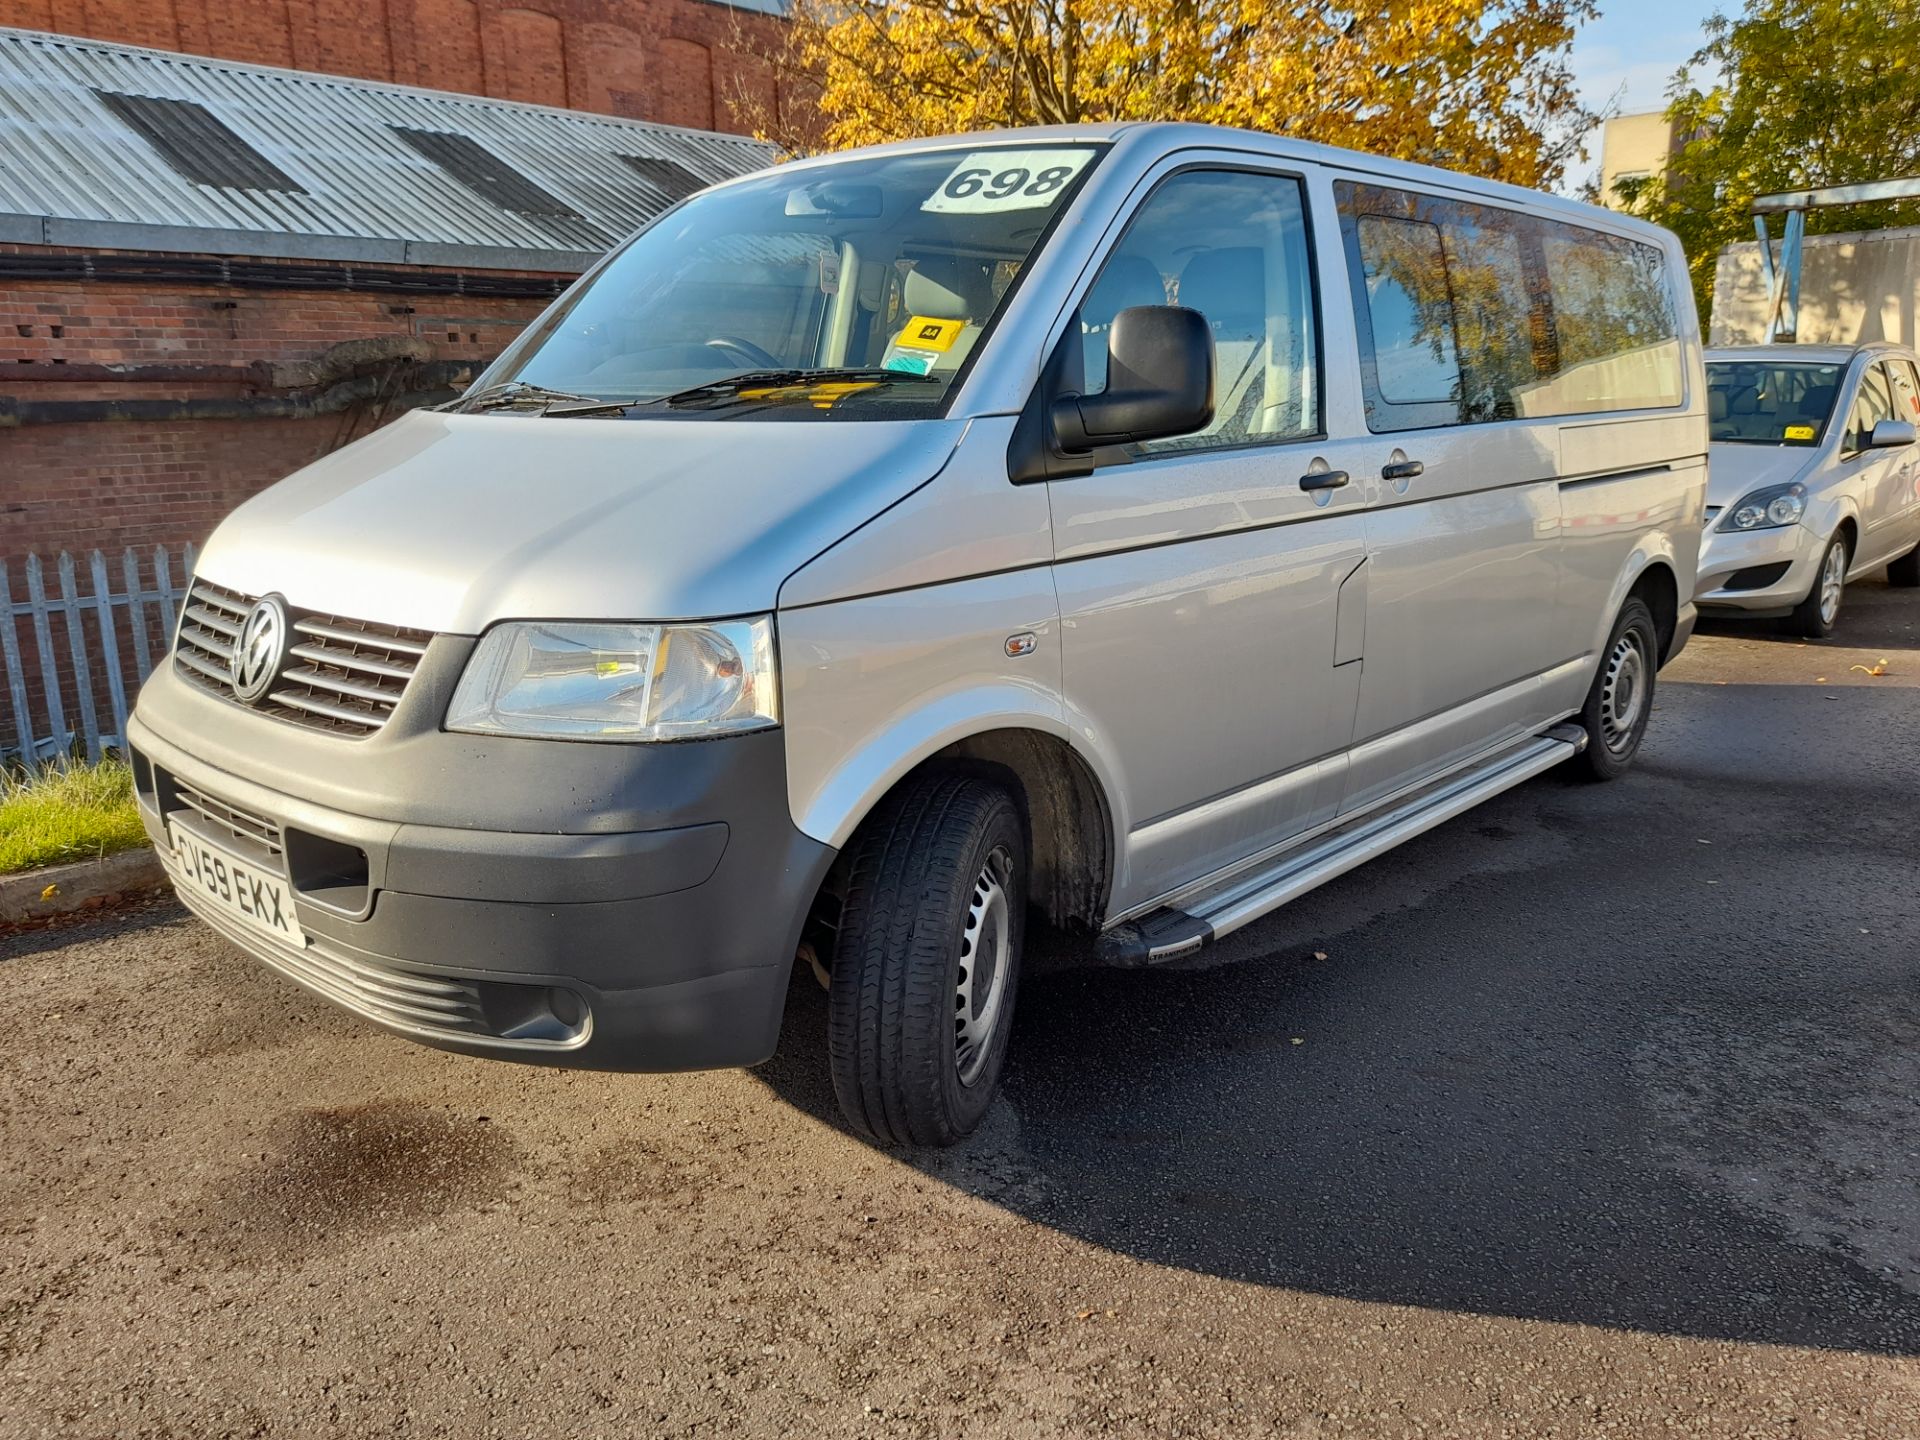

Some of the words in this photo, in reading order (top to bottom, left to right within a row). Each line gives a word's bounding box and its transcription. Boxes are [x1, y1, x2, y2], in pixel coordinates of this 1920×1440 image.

[944, 166, 1073, 199] 698
[921, 327, 939, 337] AA
[178, 834, 231, 902] CV59
[233, 867, 289, 932] EKX
